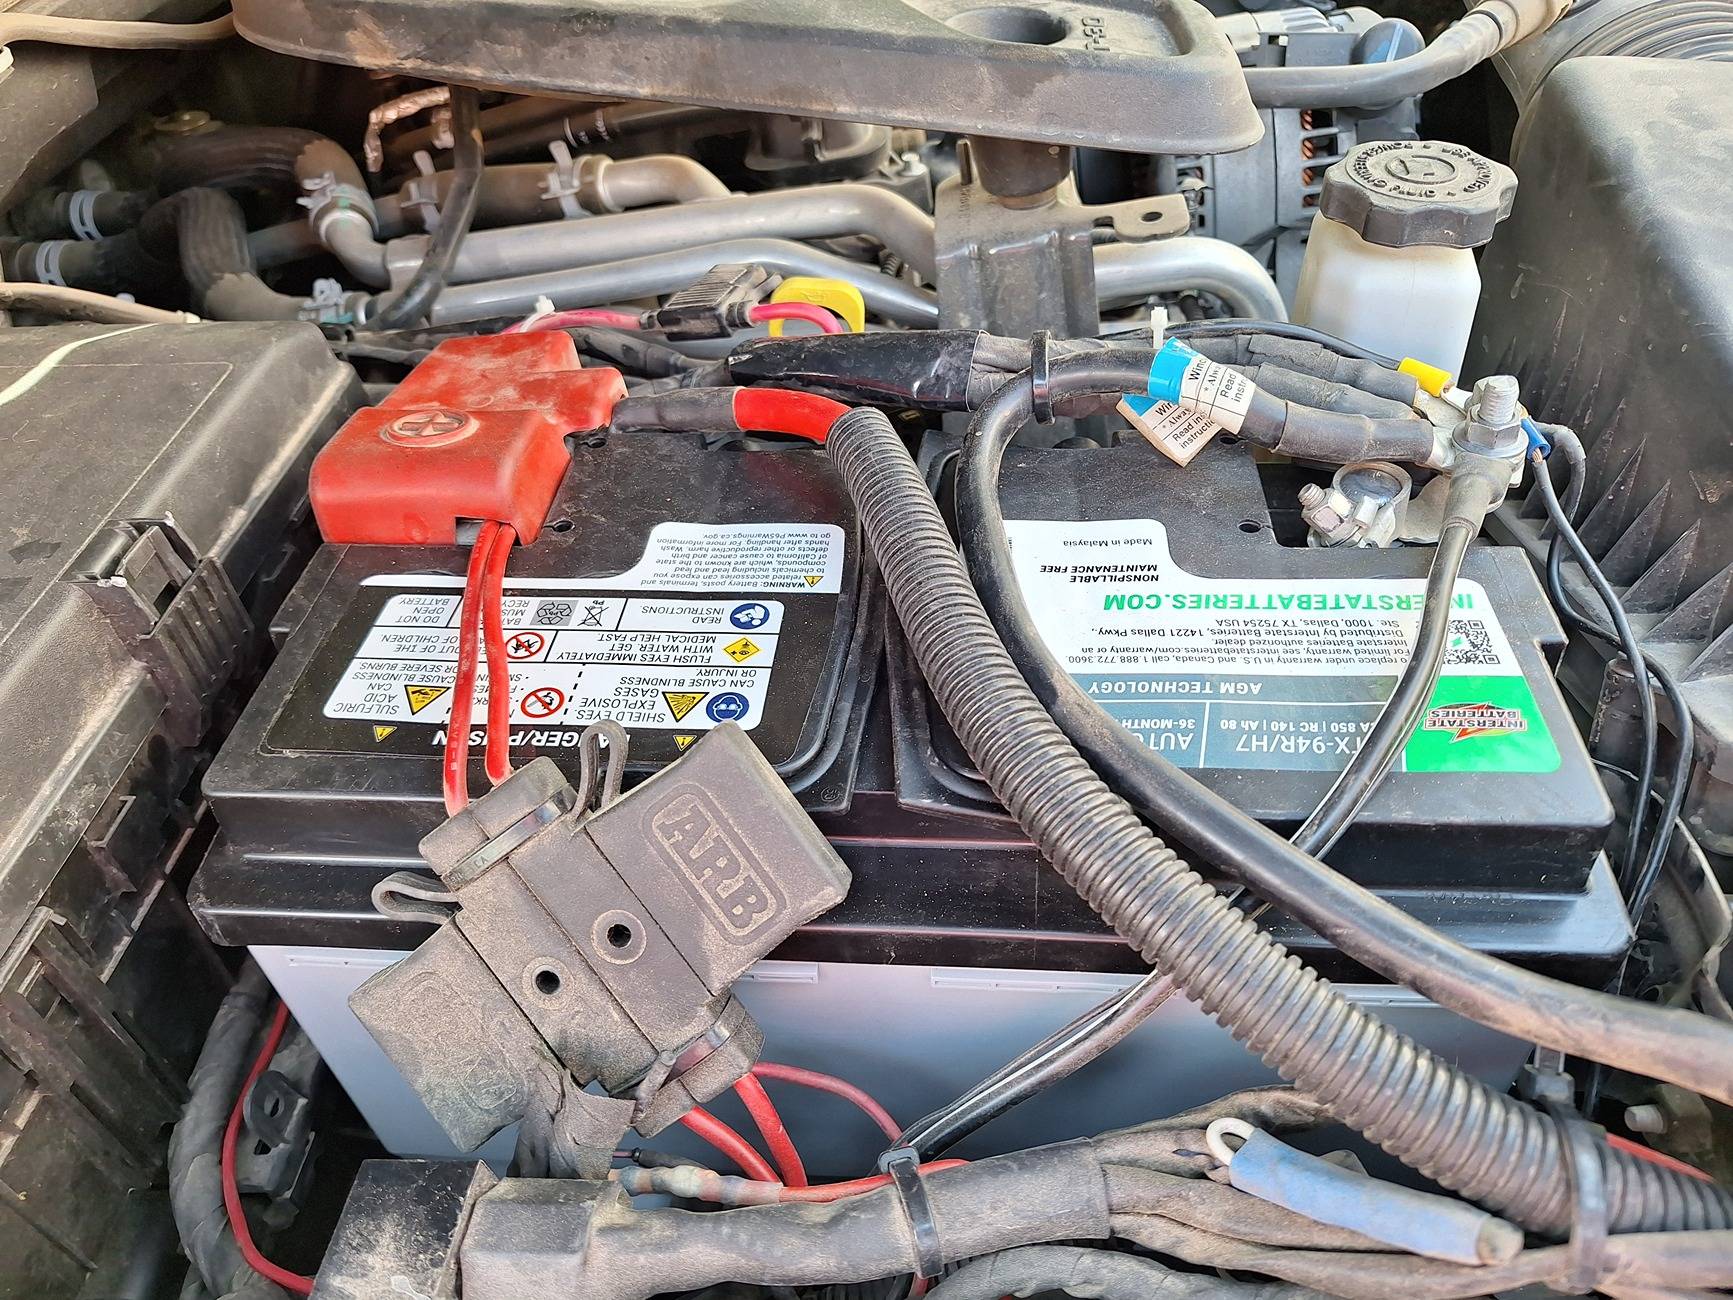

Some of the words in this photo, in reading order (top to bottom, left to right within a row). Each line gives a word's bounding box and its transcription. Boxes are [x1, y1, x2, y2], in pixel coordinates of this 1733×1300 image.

[1220, 373, 1236, 398] Read
[1172, 421, 1194, 441] Read
[657, 538, 704, 546] information
[1063, 538, 1108, 548] Malaysia
[1123, 538, 1152, 547] Made
[712, 545, 761, 553] reproductive
[776, 559, 826, 567] compounds,
[733, 566, 769, 574] including
[1040, 565, 1068, 573] FREE
[1071, 564, 1158, 574] MAINTENANCE
[701, 579, 726, 587] posts,
[1069, 574, 1159, 583] NONSPILLABLE
[399, 597, 450, 605] BATTERY.
[1104, 594, 1473, 610] INERSTATEBATTERIES.COM
[640, 606, 725, 615] INSTRUCTIONS.
[1300, 618, 1338, 628] Dallas,
[1341, 618, 1372, 627] 1000,
[1376, 620, 1400, 628] Ste.
[1091, 628, 1128, 636] Pkwy.,
[1130, 628, 1165, 636] Dallas
[1170, 628, 1204, 636] 14221
[1206, 628, 1260, 636] Batteries,
[1323, 628, 1337, 637] by
[1340, 630, 1404, 638] Distributed
[381, 634, 440, 643] CHILDREN.
[597, 633, 628, 641] FAST.
[630, 634, 661, 642] HELP
[665, 635, 716, 643] MEDICAL
[1212, 638, 1246, 646] dealer.
[420, 645, 436, 653] OF
[609, 643, 632, 651] GET
[637, 644, 679, 653] WATER.
[683, 645, 713, 653] WITH
[1110, 646, 1279, 654] interstatebatteries.com/warranty
[1354, 648, 1390, 656] limited
[556, 652, 637, 662] IMMEDIATELY
[640, 654, 670, 662] EYES
[674, 655, 711, 663] FLUSH
[1066, 656, 1148, 664] 1.888.772.3600.
[1152, 656, 1170, 664] call
[1172, 655, 1214, 664] Canada,
[1218, 656, 1236, 664] and
[1240, 656, 1261, 664] U.S.
[1276, 656, 1322, 664] warranty
[1358, 656, 1397, 665] replace
[359, 662, 398, 671] BURNS.
[399, 664, 443, 672] SEVERE
[352, 672, 416, 682] BLINDNESS
[696, 668, 738, 677] INJURY.
[417, 675, 456, 683] CAUSE
[620, 676, 685, 686] BLINDNESS
[688, 678, 726, 687] CAUSE
[730, 679, 754, 687] CAN
[1088, 681, 1212, 694] TECHNOLOGY
[1220, 682, 1262, 694] AGM
[614, 687, 659, 698] GASES
[364, 693, 397, 702] ACID
[579, 698, 655, 709] EXPLOSIVE
[333, 703, 399, 714] SULFURIC
[574, 710, 610, 720] EYES.
[614, 711, 666, 723] SHIELD
[1430, 710, 1517, 719] BATTERIES
[1122, 718, 1196, 729] 36-MONTH
[1220, 720, 1237, 730] 80
[1241, 720, 1258, 730] Ah
[1270, 721, 1296, 731] 140
[1300, 722, 1318, 732] RC
[1330, 722, 1356, 732] 850
[1427, 719, 1524, 728] INTERSTATE
[1235, 734, 1362, 754] TX-94R/H7
[656, 802, 770, 929] ARB
